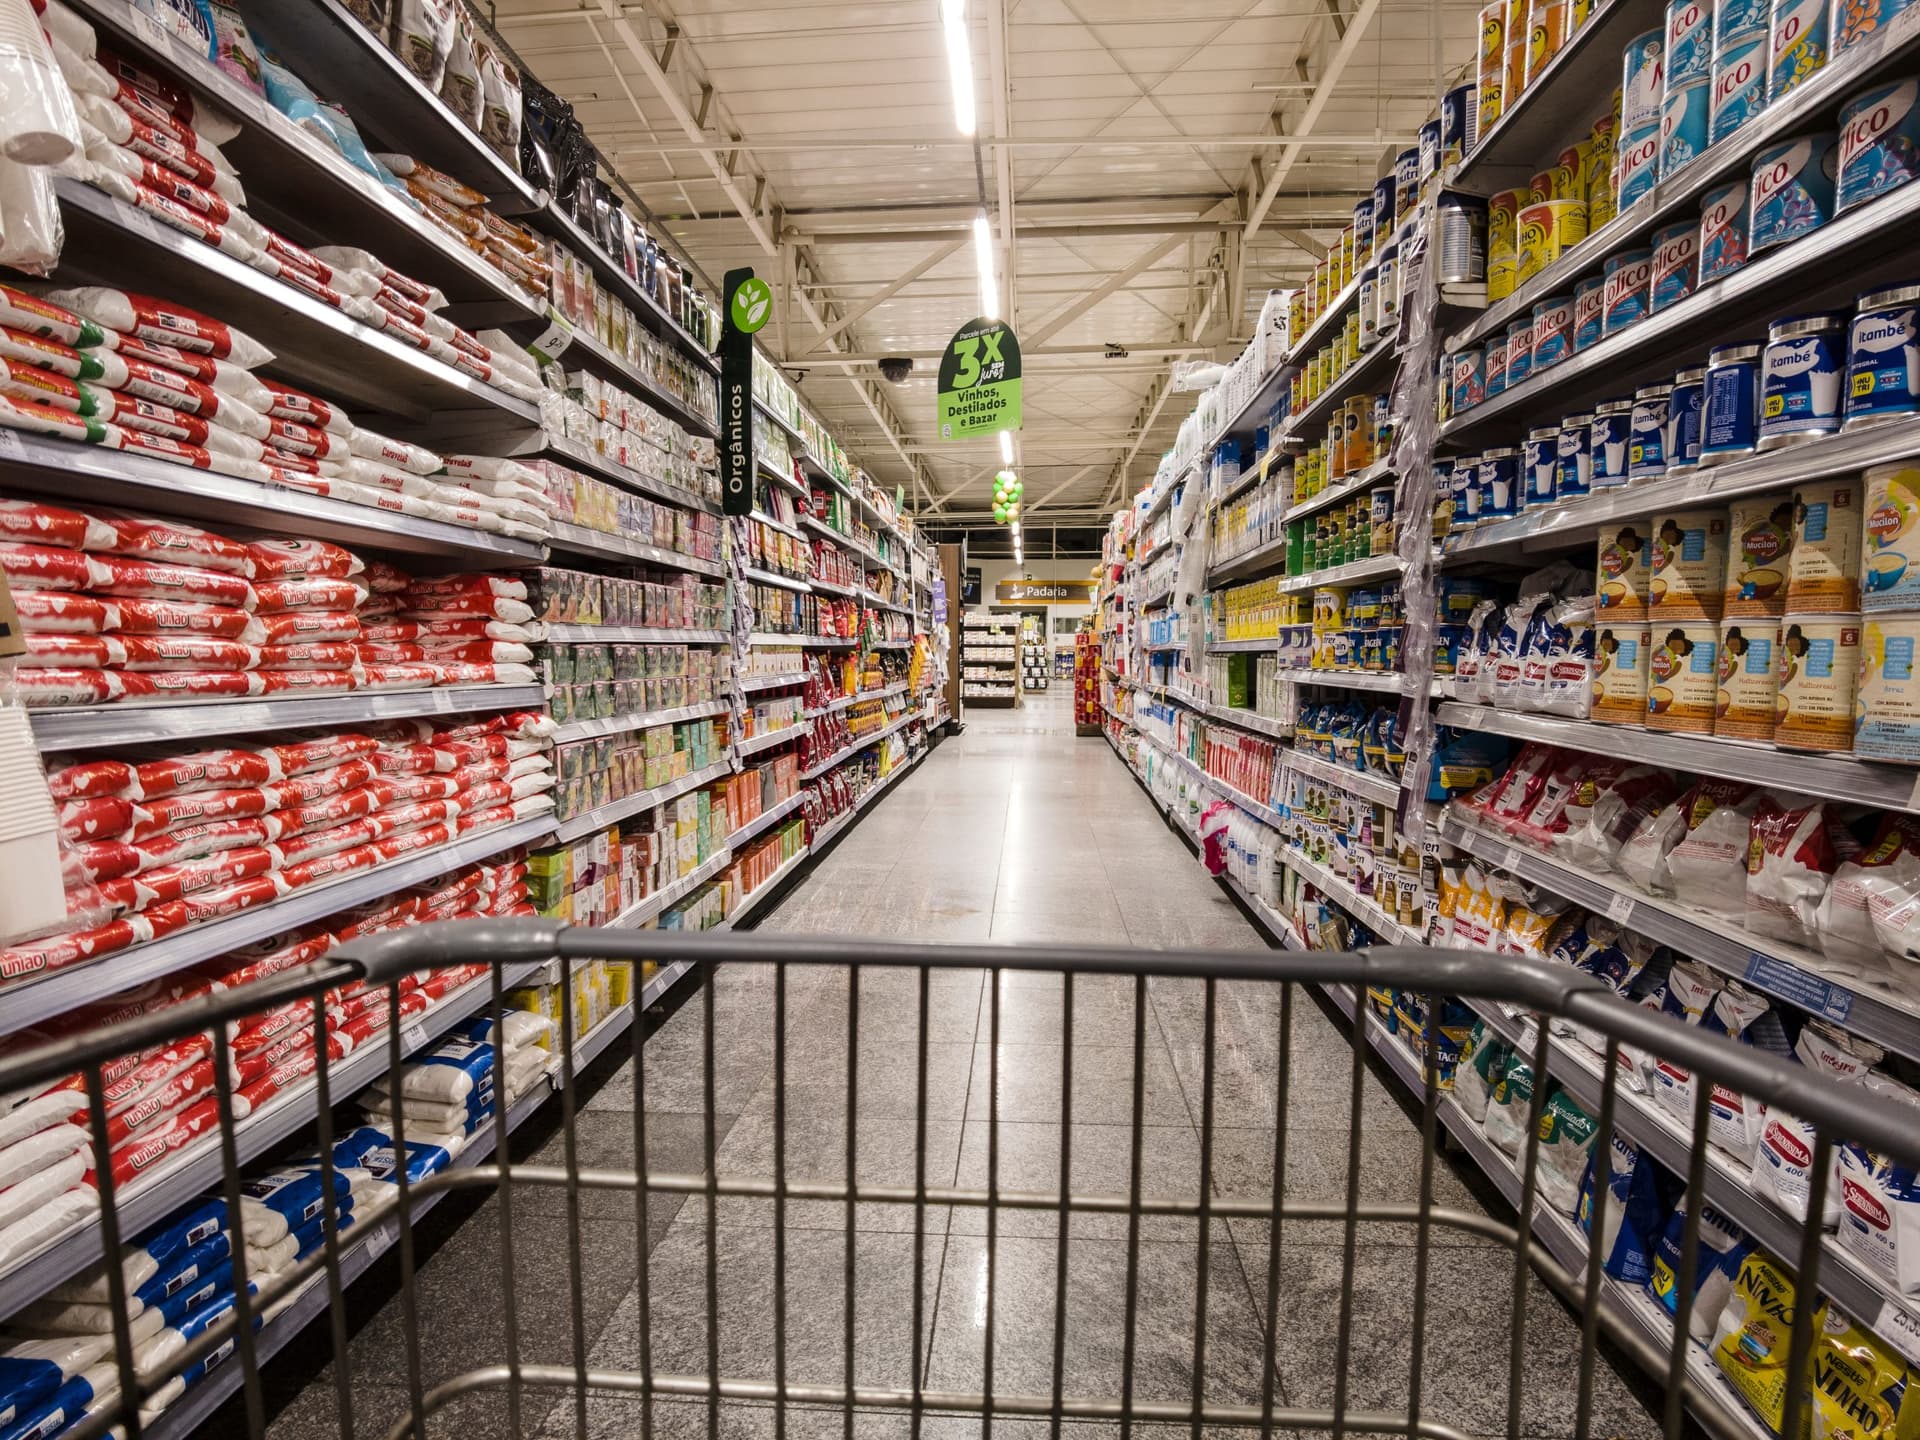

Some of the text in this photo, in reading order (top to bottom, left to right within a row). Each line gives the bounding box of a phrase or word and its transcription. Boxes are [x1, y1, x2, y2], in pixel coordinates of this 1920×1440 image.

[1859, 323, 1905, 344] itambé
[1771, 351, 1811, 368] itambé
[958, 388, 1000, 402] Vinhos,
[948, 398, 1006, 417] Destilados
[969, 413, 997, 425] Bazar
[729, 384, 745, 493] Orgânicos
[1870, 516, 1898, 529] Mucilon
[1747, 540, 1777, 550] Mucilon
[1027, 586, 1067, 597] Padaria
[1847, 633, 1854, 641] 6
[1785, 1166, 1803, 1177] 400
